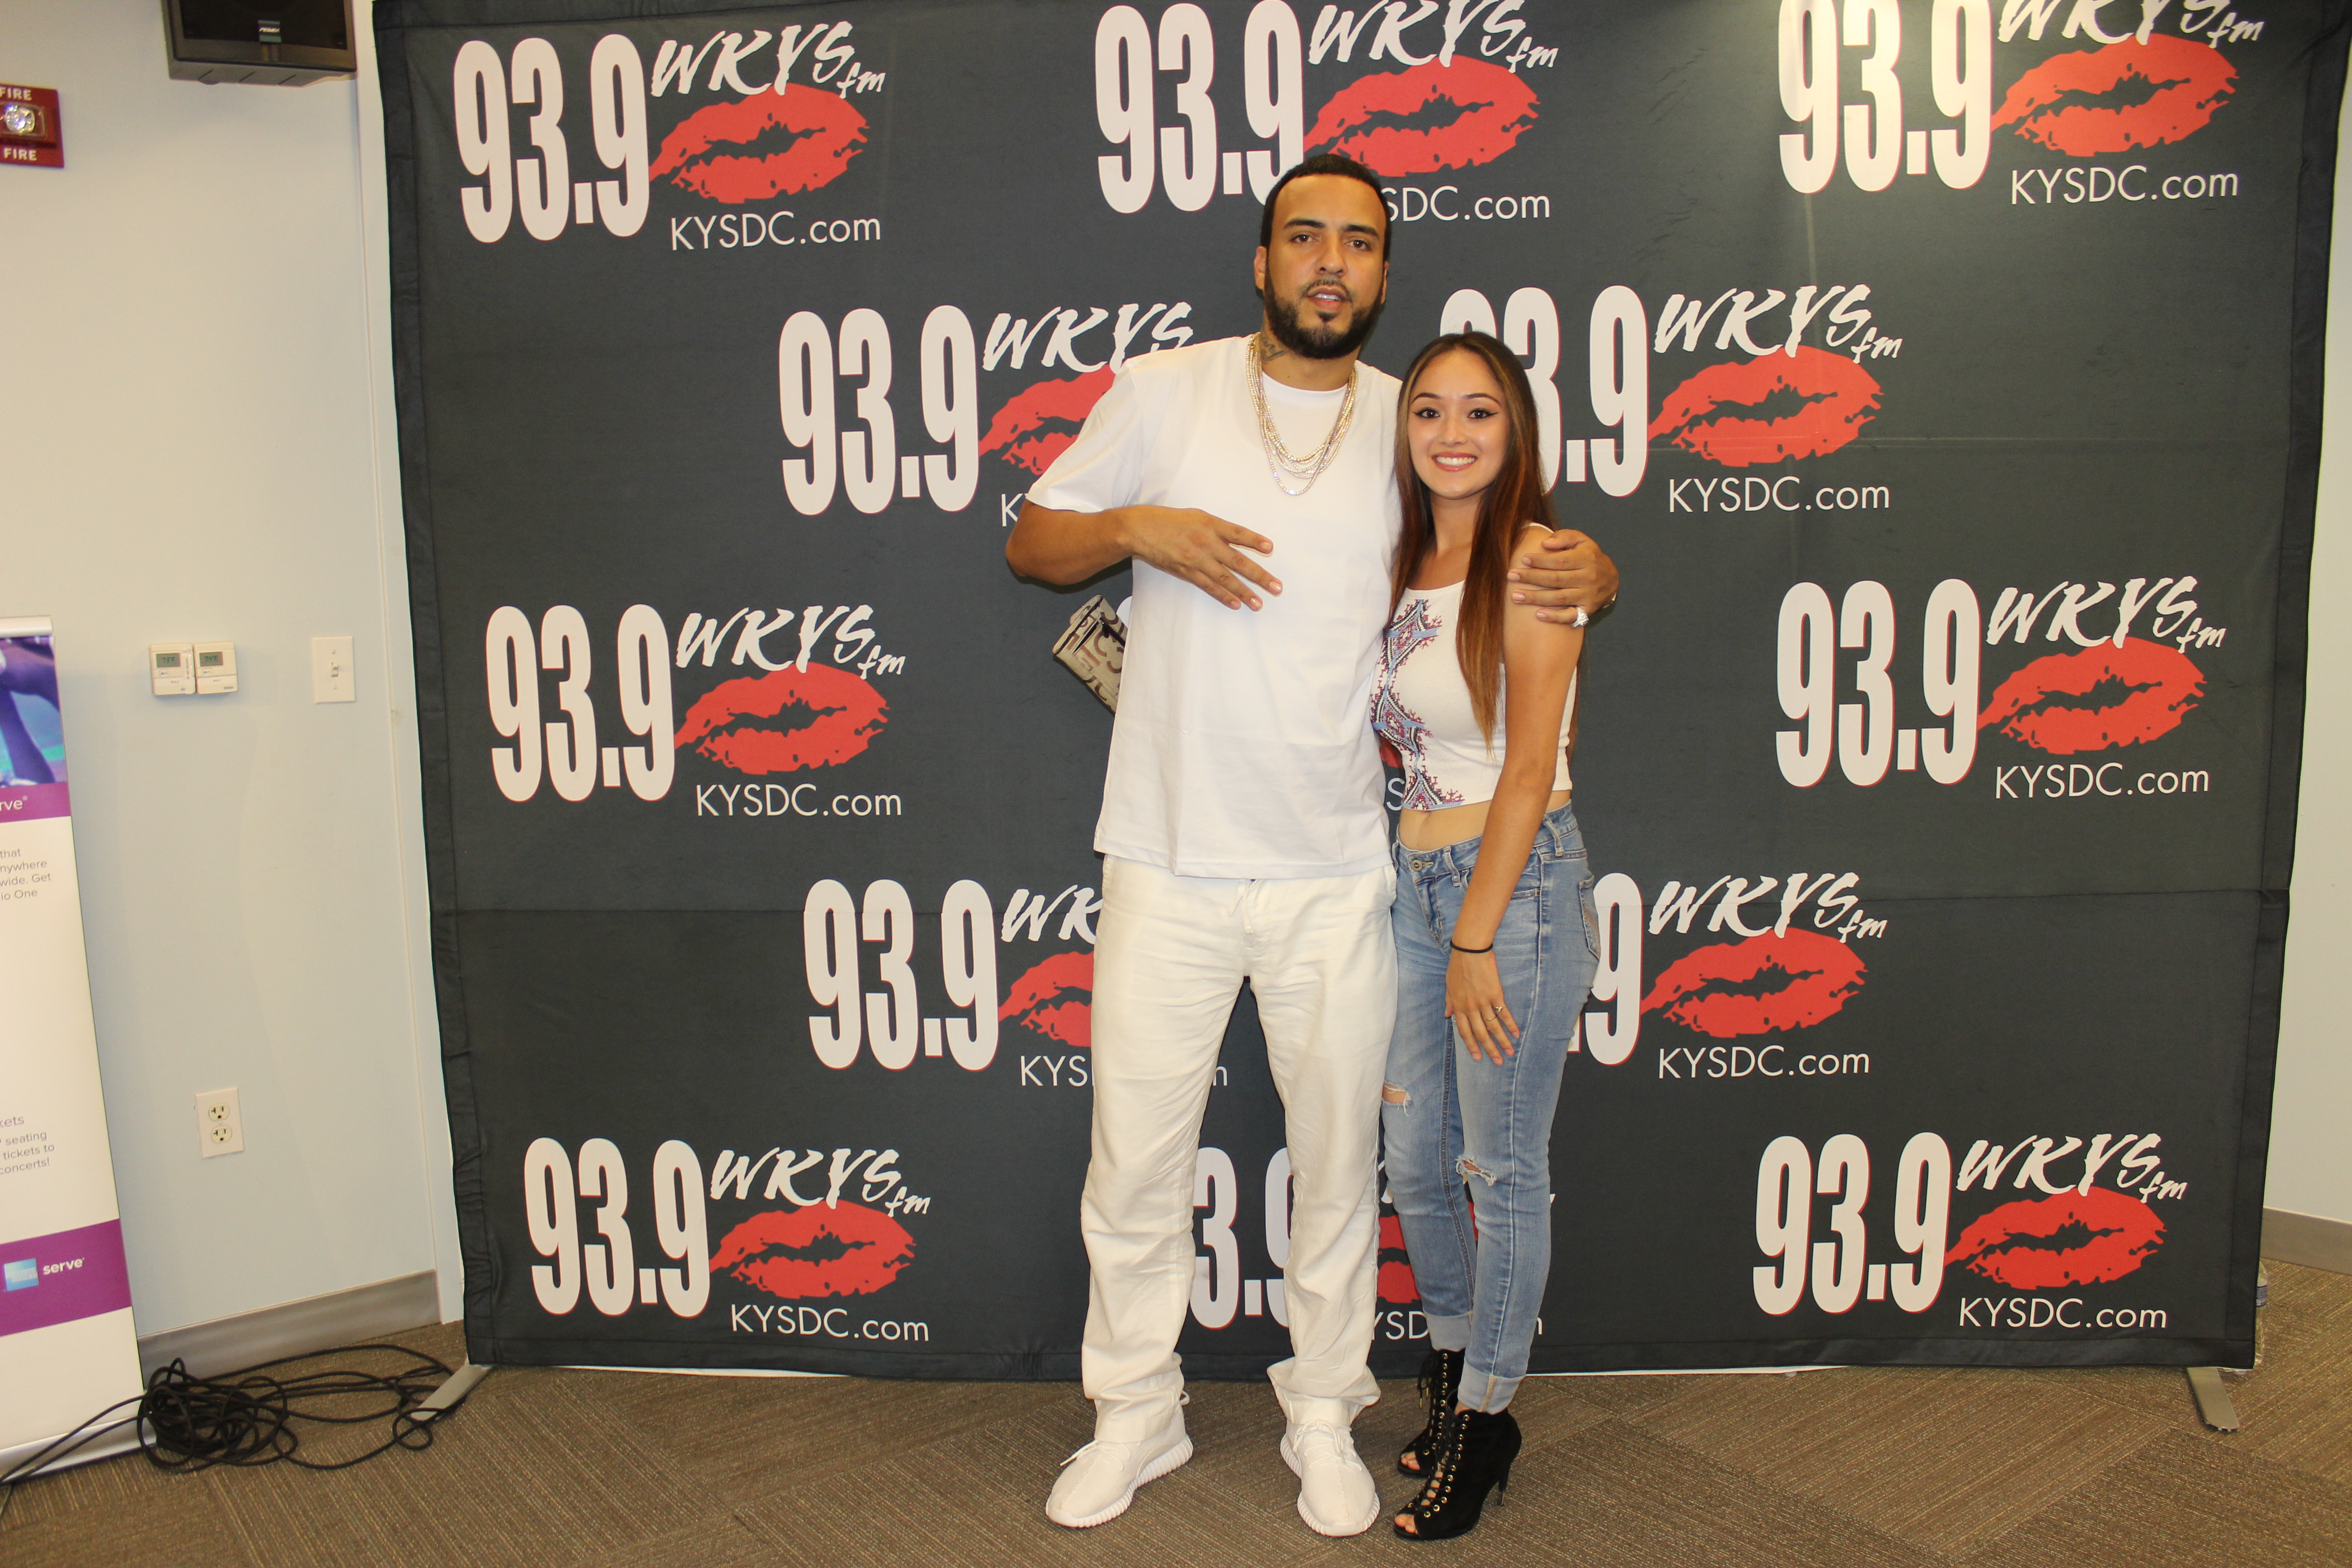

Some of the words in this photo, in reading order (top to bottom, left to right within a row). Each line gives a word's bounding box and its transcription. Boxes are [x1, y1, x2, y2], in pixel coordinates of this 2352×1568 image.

[0, 87, 32, 101] FIRE
[1095, 0, 1304, 213] 93.9
[1308, 0, 1526, 68] WKYS
[1506, 36, 1559, 74] fm
[1777, 0, 1994, 194] 93.9
[2208, 13, 2264, 48] fm
[453, 34, 650, 243] 93.9
[651, 21, 855, 96] WKYS
[838, 62, 886, 99] fm
[4, 148, 37, 161] FIRE
[1381, 186, 1550, 221] SDC.com
[2012, 165, 2238, 205] KYSDC.com
[671, 211, 881, 250] KYSDC.com
[779, 305, 979, 515] 93.9
[982, 301, 1194, 373] WKYS
[1439, 287, 1648, 497] 3.9
[1653, 284, 1872, 358] WKYS
[1851, 327, 1903, 364] fm
[1670, 476, 1889, 513] KYSDC.com
[1776, 578, 1980, 787] 93.9
[1986, 575, 2197, 649] WKYS
[2176, 617, 2226, 653] fm
[486, 604, 675, 801] 93.9
[676, 604, 875, 674] WKYS
[858, 645, 906, 680] fm
[1996, 763, 2209, 799] KYSDC.com
[696, 784, 902, 816] KYSDC.com
[15, 890, 38, 899] One
[32, 873, 52, 883] Get
[1648, 872, 1859, 938] WKYS
[1838, 909, 1887, 944] fm
[804, 879, 999, 1070] 93.9
[1659, 1045, 1869, 1079] KYSDC.com
[3, 1147, 40, 1160] tickets
[44, 1144, 55, 1152] to
[6, 1132, 47, 1145] seating
[0, 1156, 50, 1175] concerts!
[524, 1137, 710, 1317] 93.9
[710, 1147, 901, 1209] WKYS
[885, 1186, 931, 1217] fm
[1753, 1132, 1950, 1314] 93.9
[1956, 1133, 2161, 1196] WKYS
[2139, 1171, 2187, 1204] fm
[731, 1304, 929, 1341] KYSDC.com
[1960, 1298, 2166, 1328] KYSDC.com
